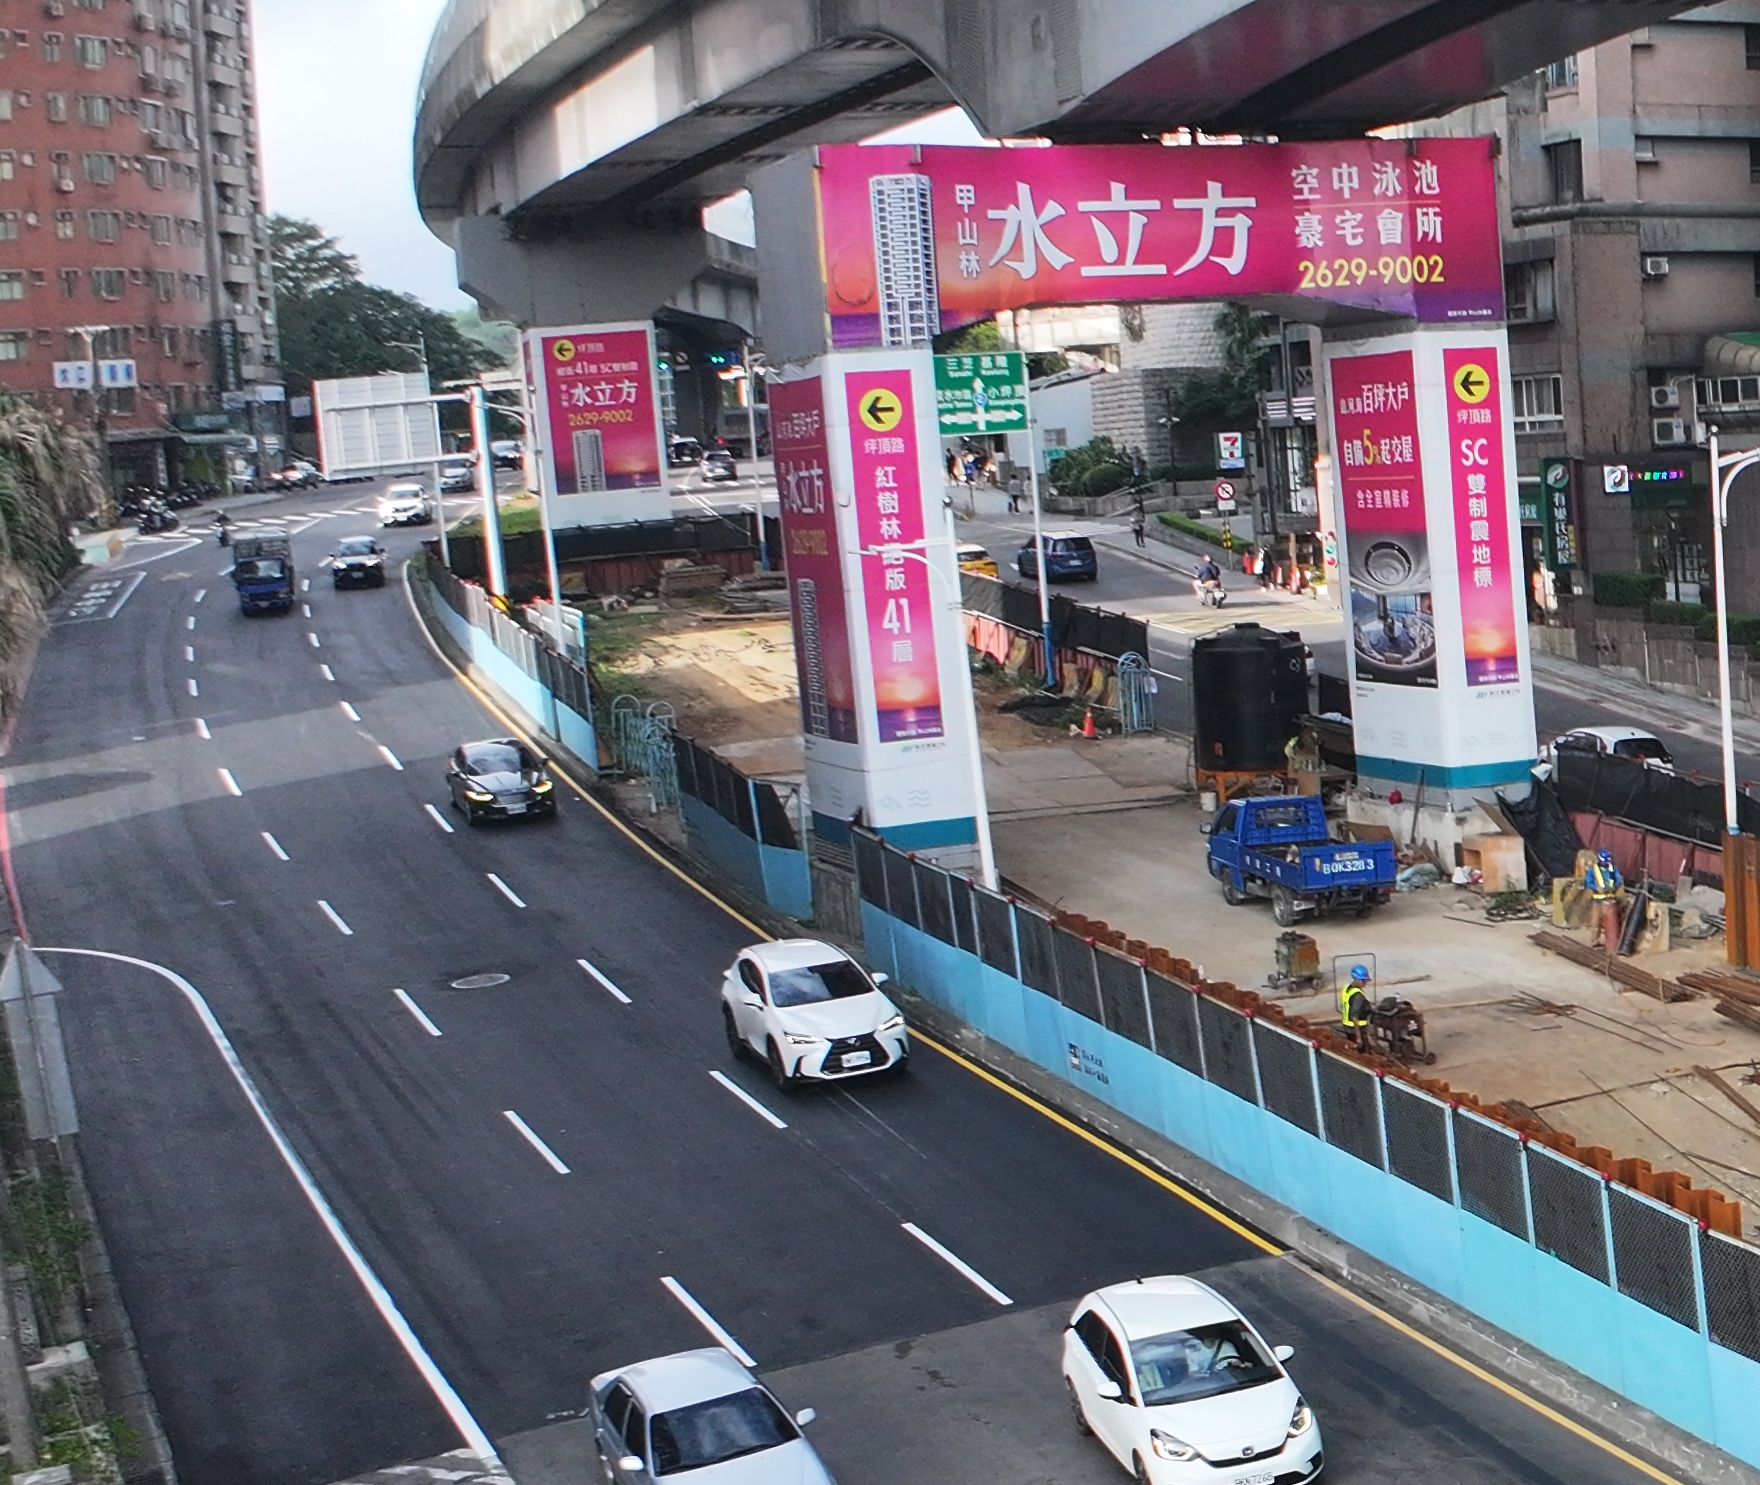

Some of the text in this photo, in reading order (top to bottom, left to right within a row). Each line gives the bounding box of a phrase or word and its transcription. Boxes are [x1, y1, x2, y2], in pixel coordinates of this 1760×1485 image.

[1291, 159, 1440, 200] 空中泳池
[955, 184, 981, 279] 甲山林
[987, 181, 1256, 280] 水立方
[1294, 207, 1443, 249] 豪宅會所
[1298, 255, 1445, 289] 2629-9002
[570, 379, 638, 407] 水立方
[568, 409, 634, 426] 2629-9002
[1457, 407, 1492, 425] 坪頂路
[864, 437, 905, 455] 坪頂路
